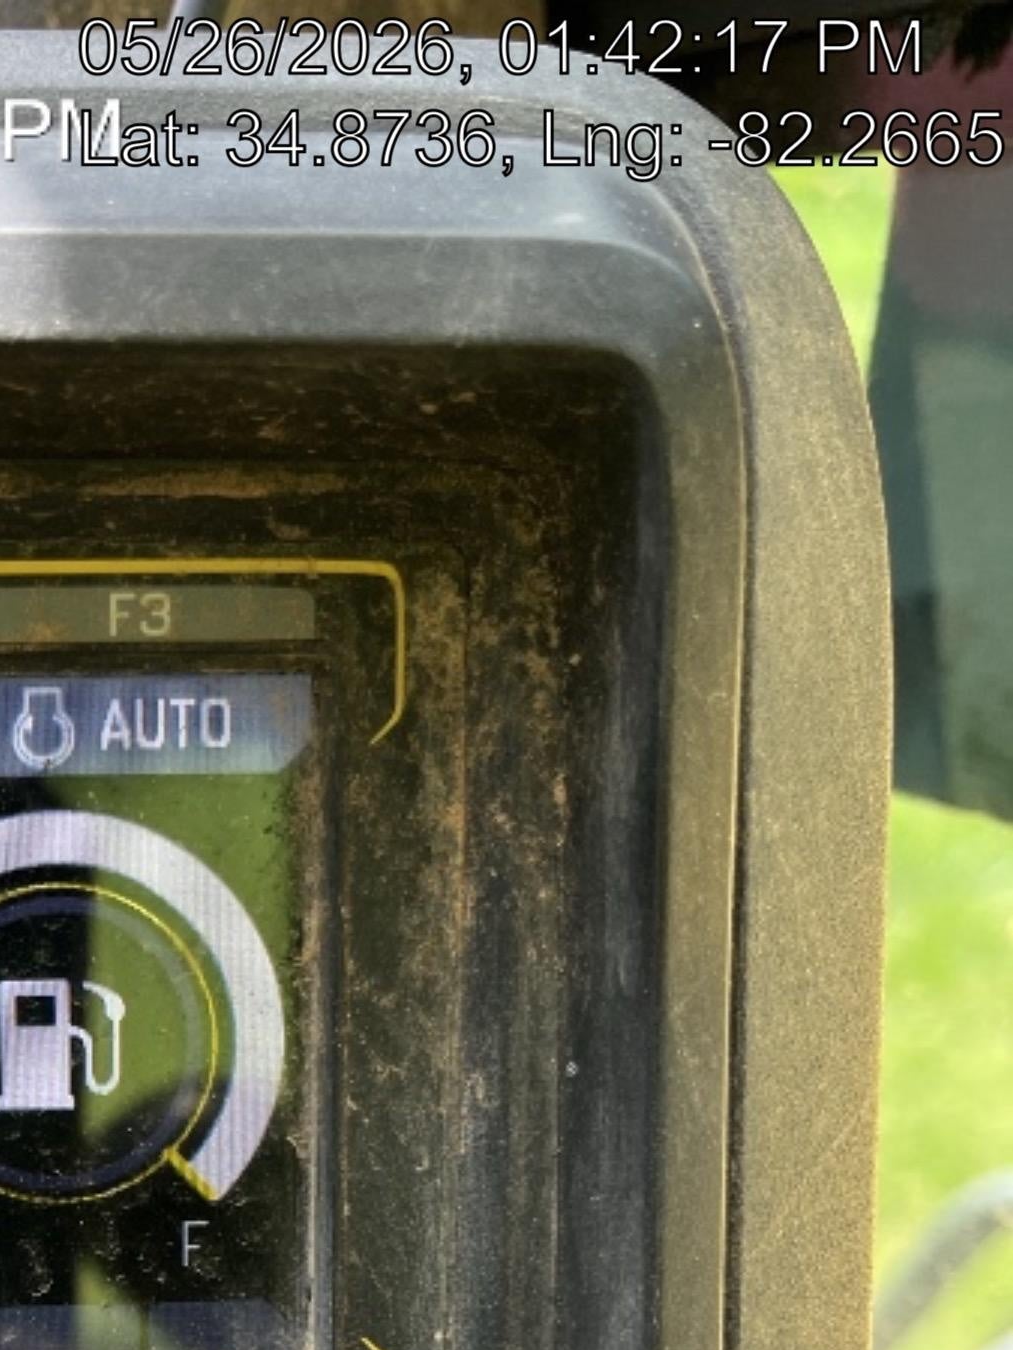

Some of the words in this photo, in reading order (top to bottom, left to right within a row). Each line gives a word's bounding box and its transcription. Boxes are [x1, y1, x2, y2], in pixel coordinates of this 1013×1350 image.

[108, 593, 172, 637] F3
[99, 698, 232, 751] AUTO
[181, 1220, 210, 1267] F
